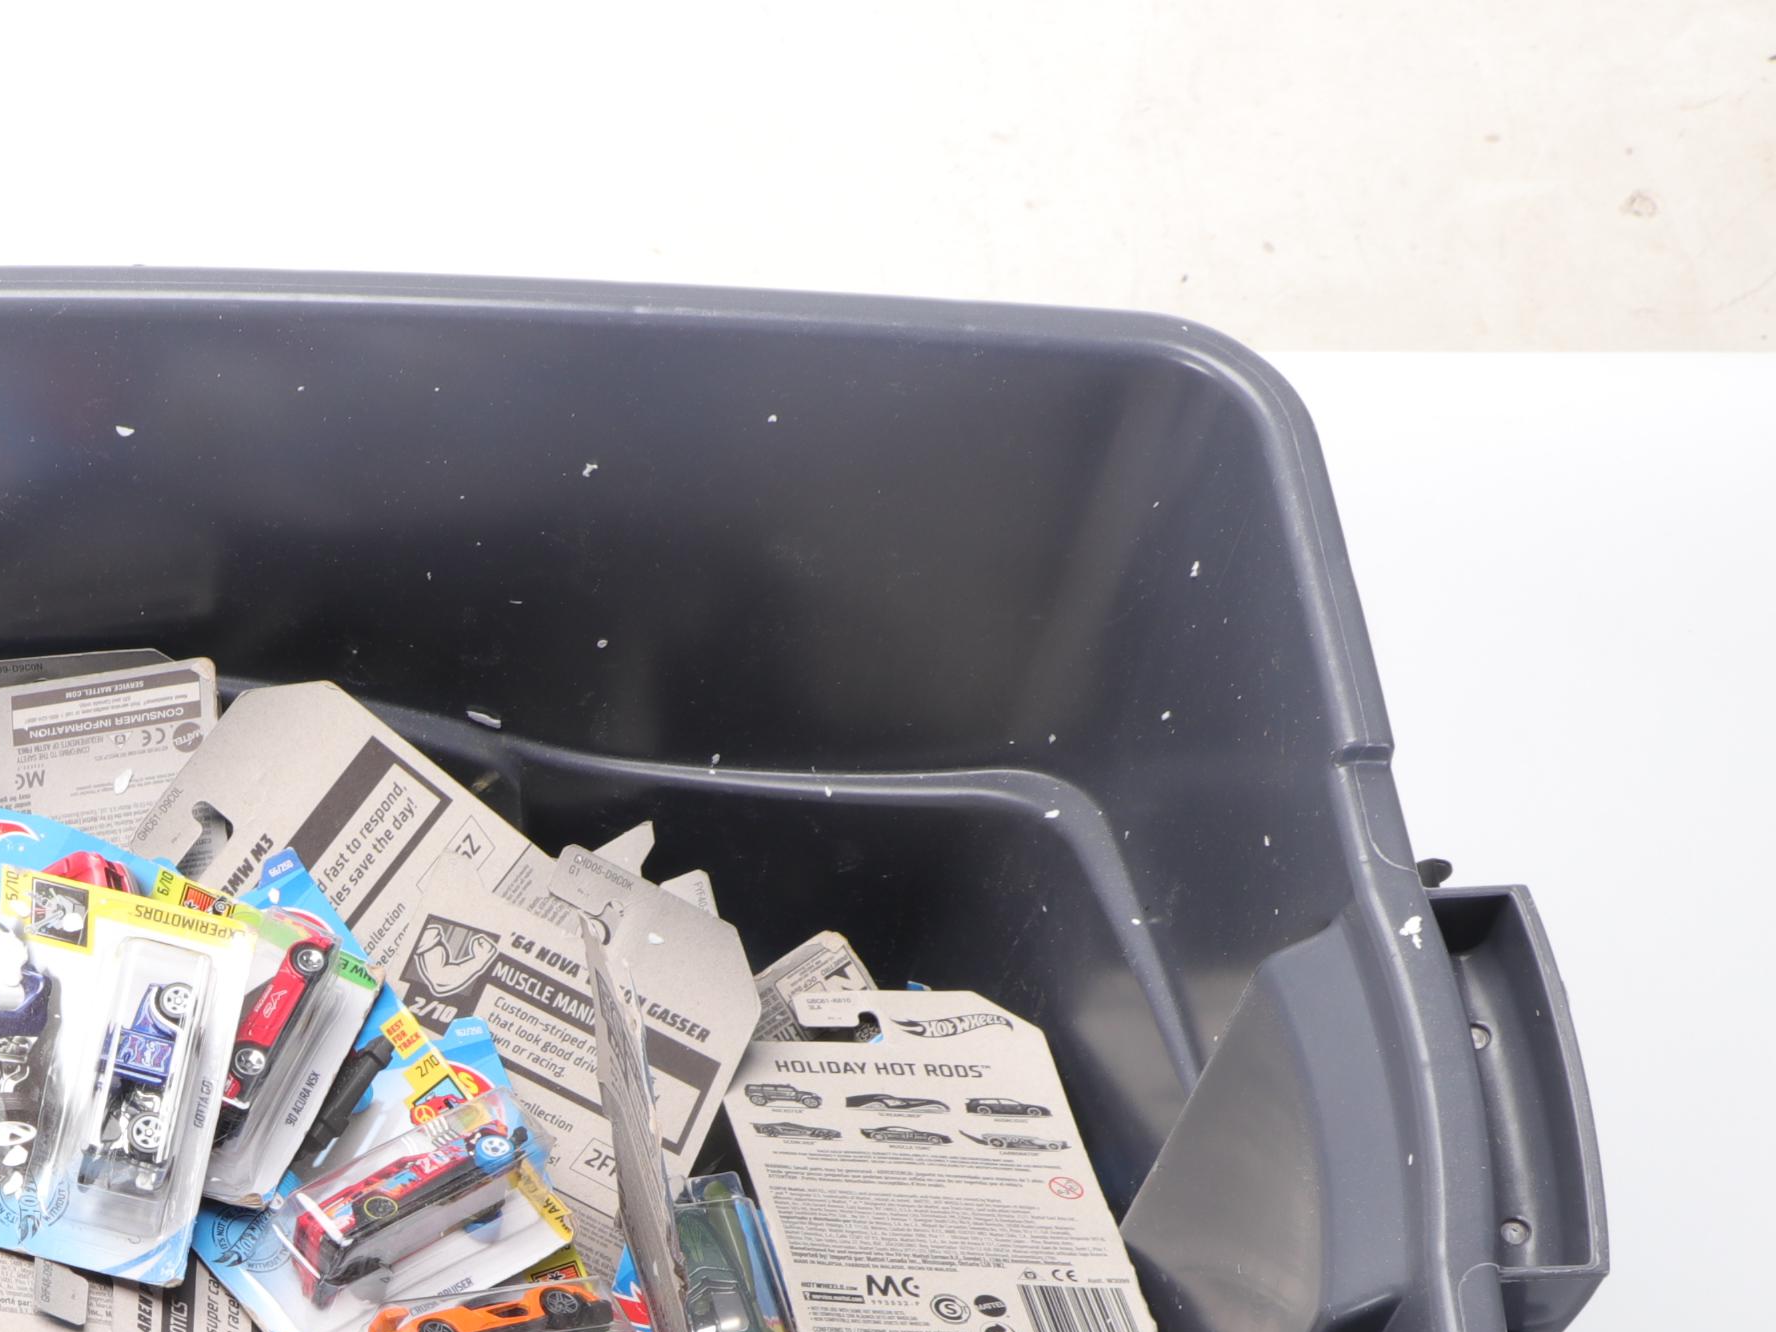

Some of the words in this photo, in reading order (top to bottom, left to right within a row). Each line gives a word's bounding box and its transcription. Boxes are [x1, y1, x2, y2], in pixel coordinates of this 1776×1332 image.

[28, 717, 107, 739] INFORMATION
[109, 705, 183, 726] CONSUMER
[321, 850, 351, 883] fast
[343, 835, 363, 855] to
[355, 778, 410, 841] respond,
[345, 852, 376, 886] save
[368, 826, 395, 855] the
[387, 796, 421, 833] day!
[506, 930, 536, 955] '64
[534, 944, 582, 979] NOVA
[645, 1000, 711, 1045] GASSER
[409, 990, 457, 1030] 2/10
[417, 1054, 439, 1077] 2/10
[775, 1059, 867, 1074] HOLIDAY
[874, 1062, 917, 1076] HOT
[193, 1095, 210, 1128] GOTTA
[202, 1079, 214, 1094] GO
[293, 1085, 312, 1116] ACURA
[305, 1070, 321, 1092] NSX
